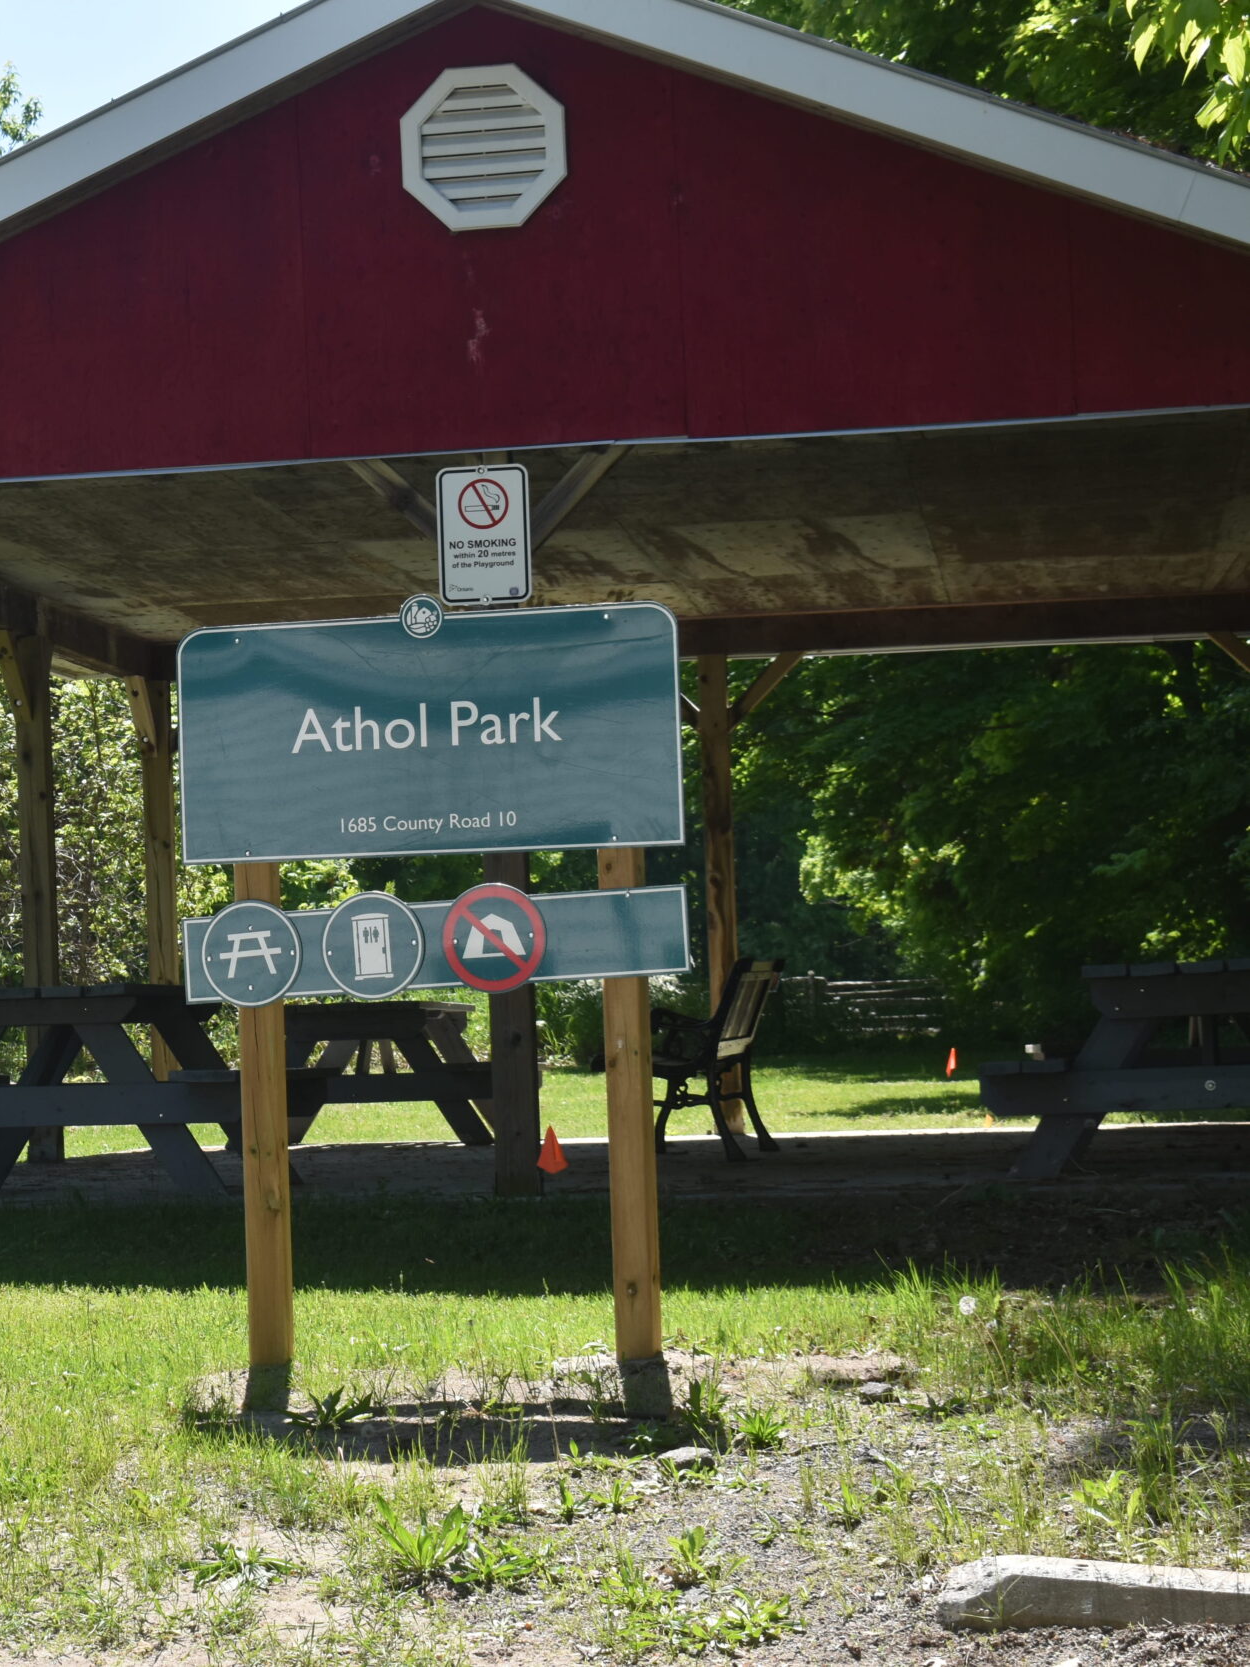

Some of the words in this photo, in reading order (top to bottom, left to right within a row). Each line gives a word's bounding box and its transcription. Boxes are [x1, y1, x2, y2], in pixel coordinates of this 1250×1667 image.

[449, 541, 464, 549] NO
[467, 538, 516, 548] SMOKING
[473, 560, 515, 568] Playground
[291, 702, 428, 753] Athol
[450, 696, 563, 747] Park
[341, 816, 377, 834] 1685
[383, 815, 444, 835] County
[449, 812, 491, 829] Road
[499, 811, 517, 827] 10
